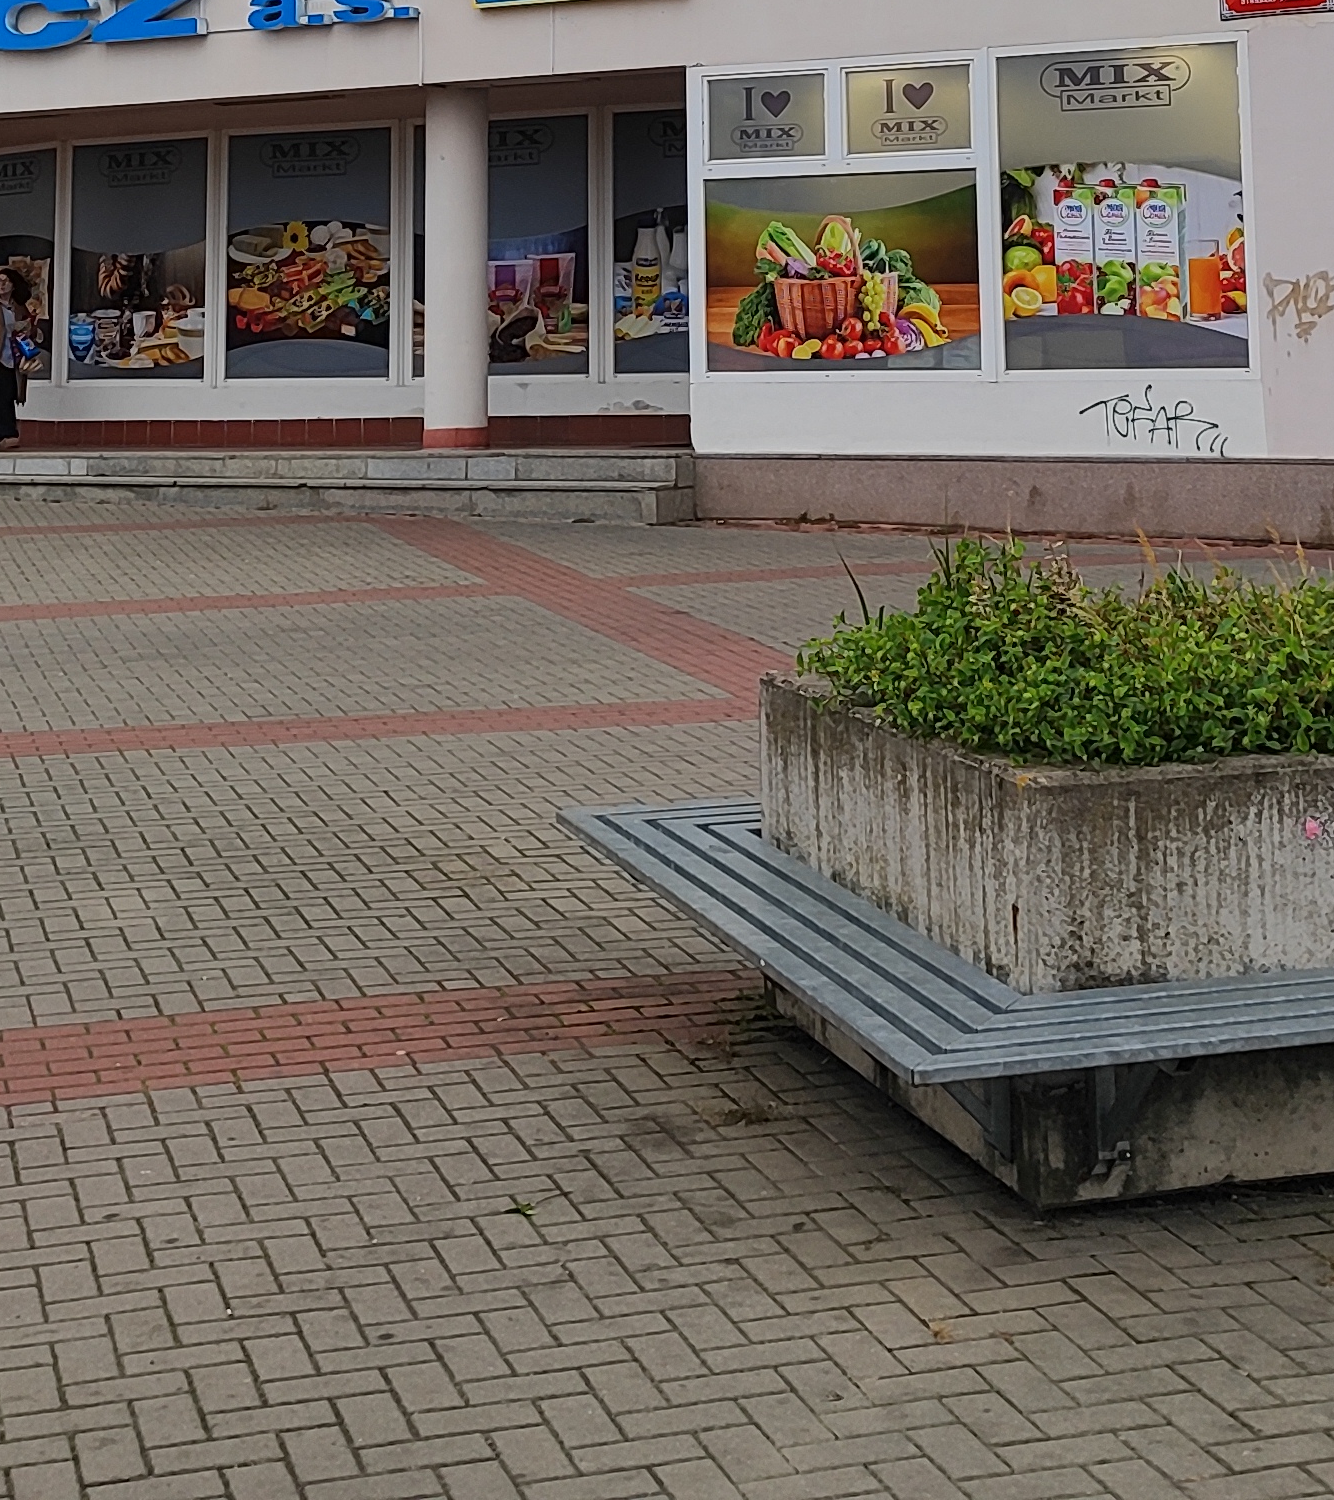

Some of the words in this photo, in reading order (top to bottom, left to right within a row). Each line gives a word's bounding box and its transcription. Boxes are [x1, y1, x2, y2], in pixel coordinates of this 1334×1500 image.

[1054, 61, 1177, 88] MIX
[743, 86, 755, 121] I
[882, 78, 896, 114] I
[1066, 89, 1165, 106] Markt
[739, 126, 797, 140] MIX
[879, 119, 940, 134] MIX
[742, 141, 790, 151] Markt
[884, 134, 934, 143] Markt
[270, 140, 351, 160] MIX
[106, 148, 174, 170] MIX
[275, 160, 343, 174] Markt
[111, 169, 167, 184] Markt
